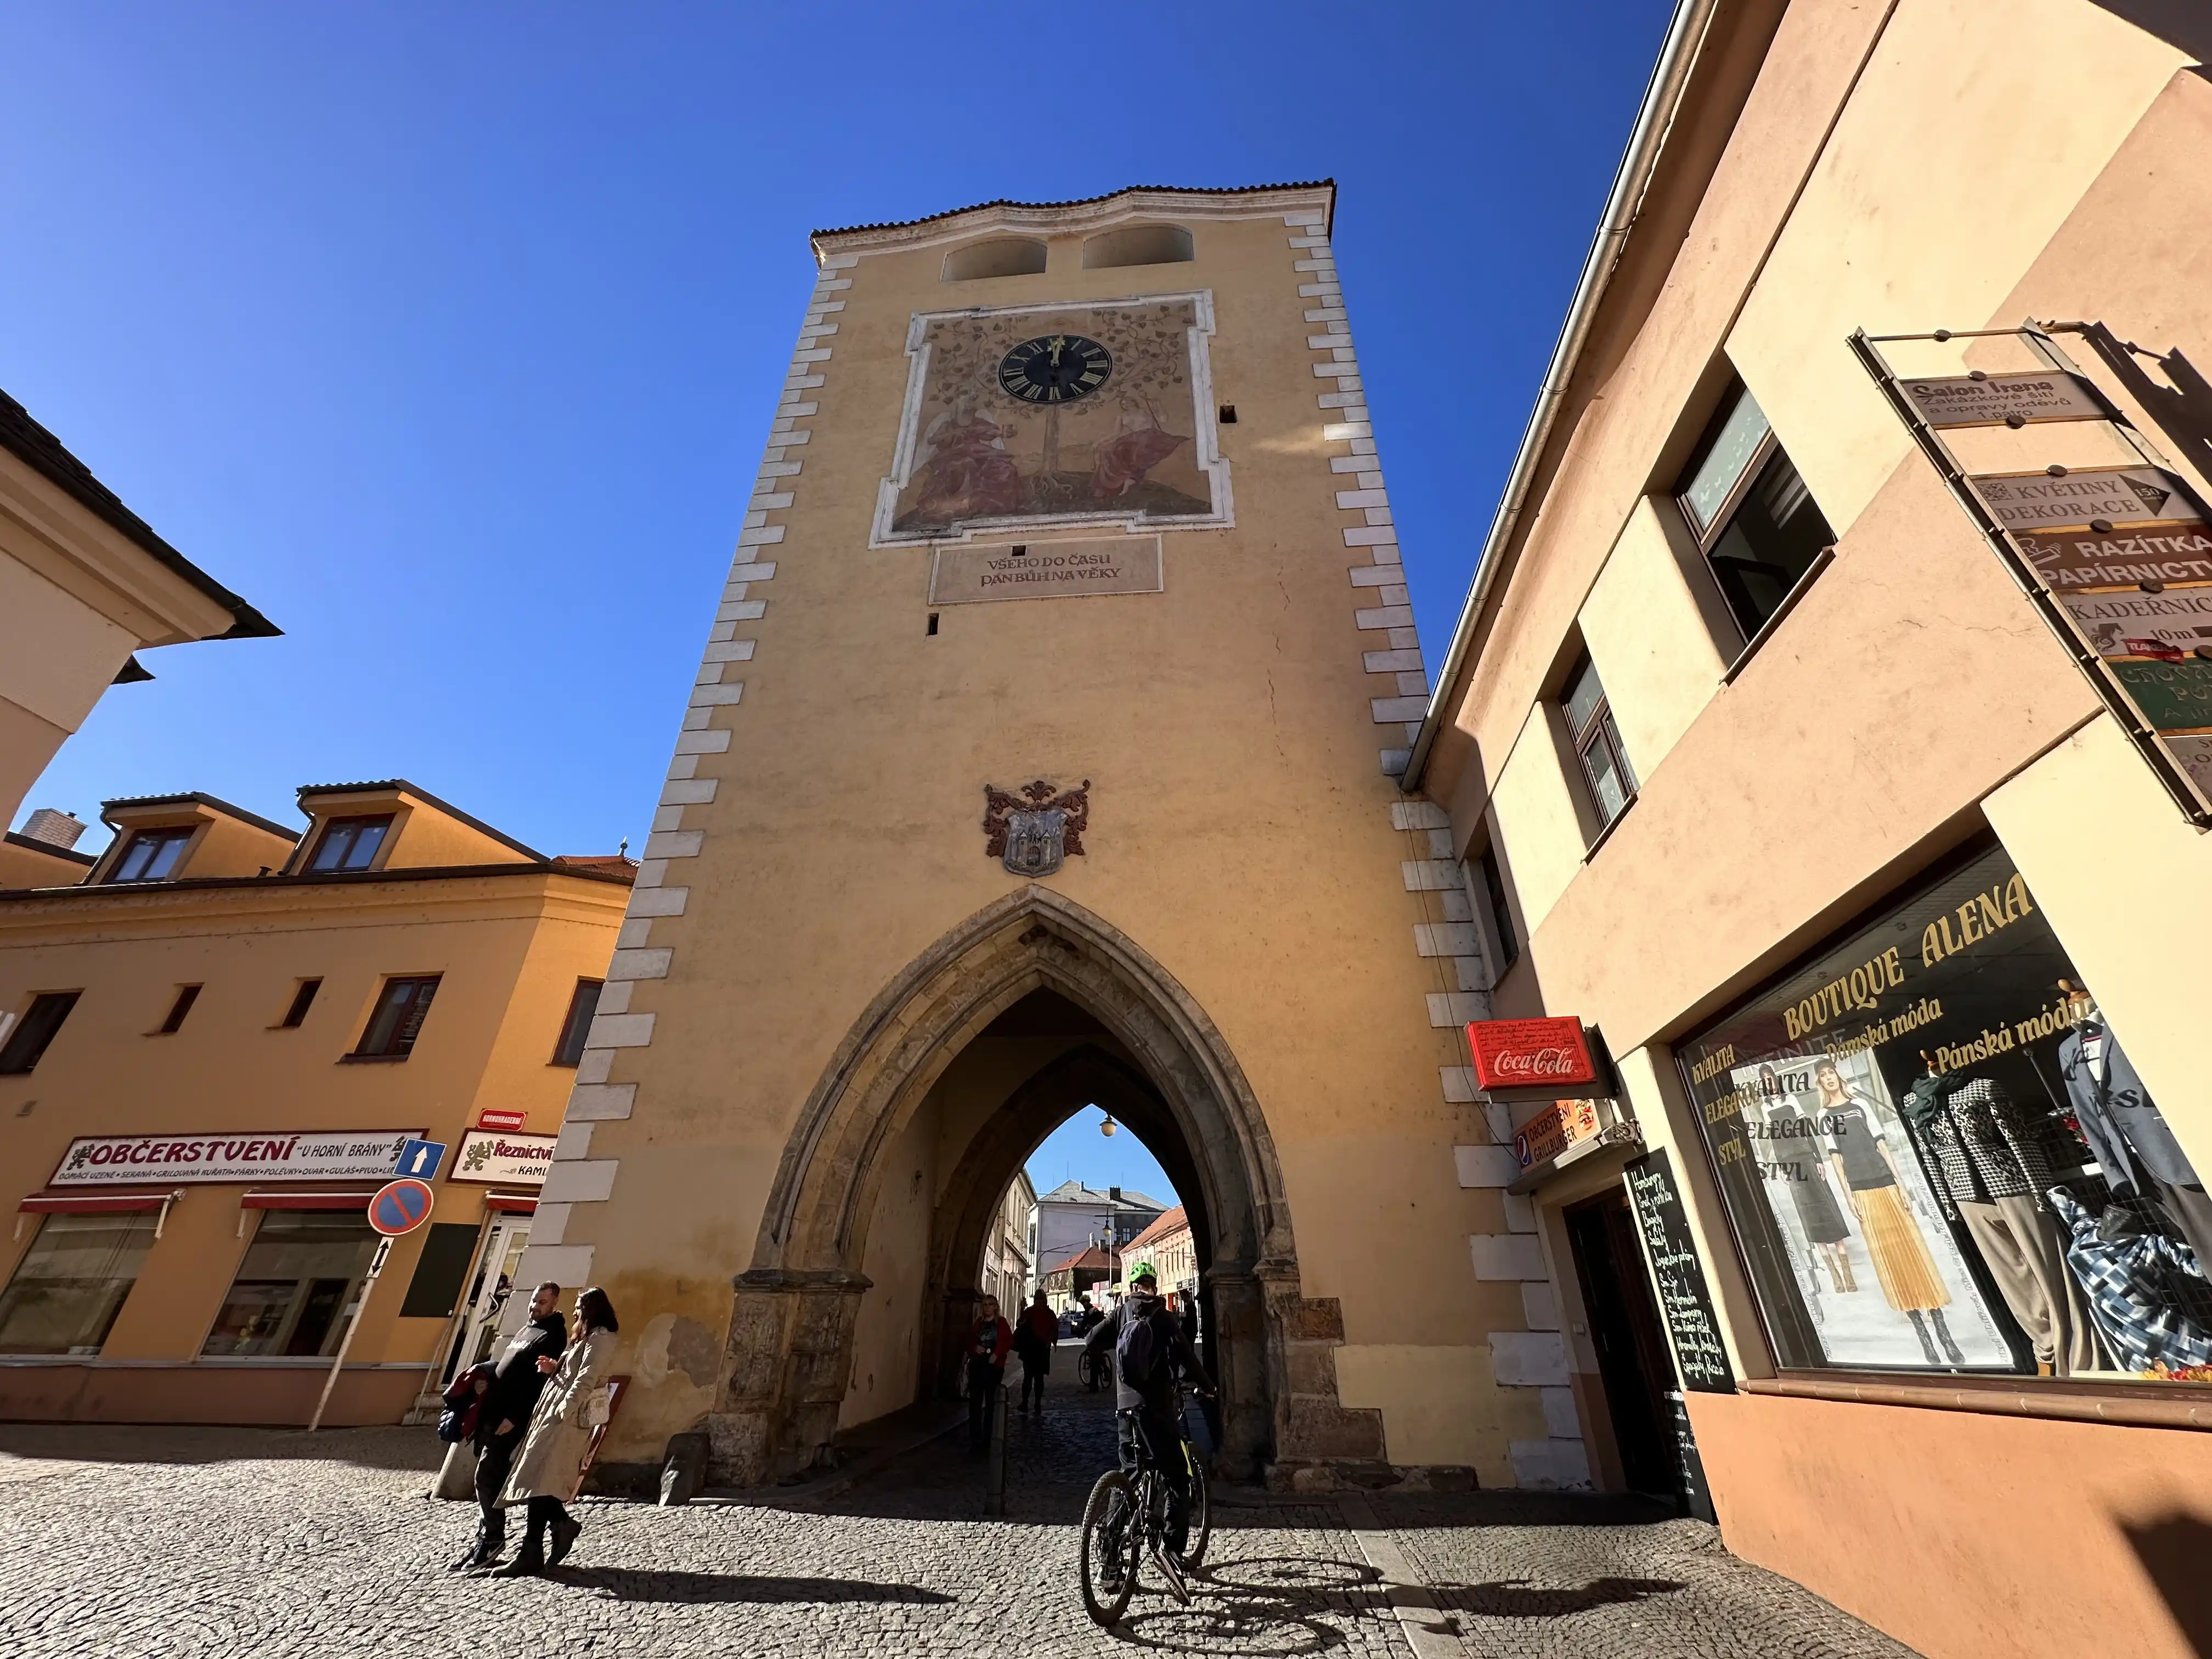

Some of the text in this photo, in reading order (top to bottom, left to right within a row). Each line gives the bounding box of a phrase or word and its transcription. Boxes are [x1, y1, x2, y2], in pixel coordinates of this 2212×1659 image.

[1912, 381, 2054, 398] Salon Irena
[1922, 391, 2054, 405] Zakázkové šití
[1946, 402, 2007, 413] opravy
[2014, 397, 2072, 408] oděvů
[2014, 478, 2160, 499] KVĚTINY 150
[1997, 499, 2142, 521] DEKORACE
[2074, 534, 2212, 558] RAZÍTKA
[987, 553, 1110, 570] VŠEHO DO ČASU
[981, 566, 1122, 587] PÁN BŮH NA VĚKY
[1783, 872, 2033, 1041] BOUTIQUE ALENA
[1825, 997, 1944, 1063] Dámská móda
[1935, 1022, 2015, 1074] Pánská
[2015, 996, 2090, 1045] móda
[1494, 1047, 1574, 1077] Coca-Cola
[1691, 1043, 1736, 1085] KVALITA
[1704, 1081, 1760, 1125] ELEGANCE
[89, 1135, 301, 1165] OBČERSTVENÍ
[311, 1143, 348, 1158] HORNÍ
[493, 1138, 555, 1160] Řeznictví
[1534, 1125, 1577, 1163] GRILLBURGER
[1718, 1137, 1747, 1165] STYL
[58, 1171, 90, 1180] DOMÁCÍ
[121, 1169, 152, 1178] SEKANÁ
[156, 1168, 200, 1177] GRILOVANÁ
[201, 1168, 231, 1176] KUŘATA
[234, 1166, 261, 1176] PÁRKY
[263, 1166, 300, 1175] POLÉVKY
[329, 1165, 356, 1175] GULÁŠ
